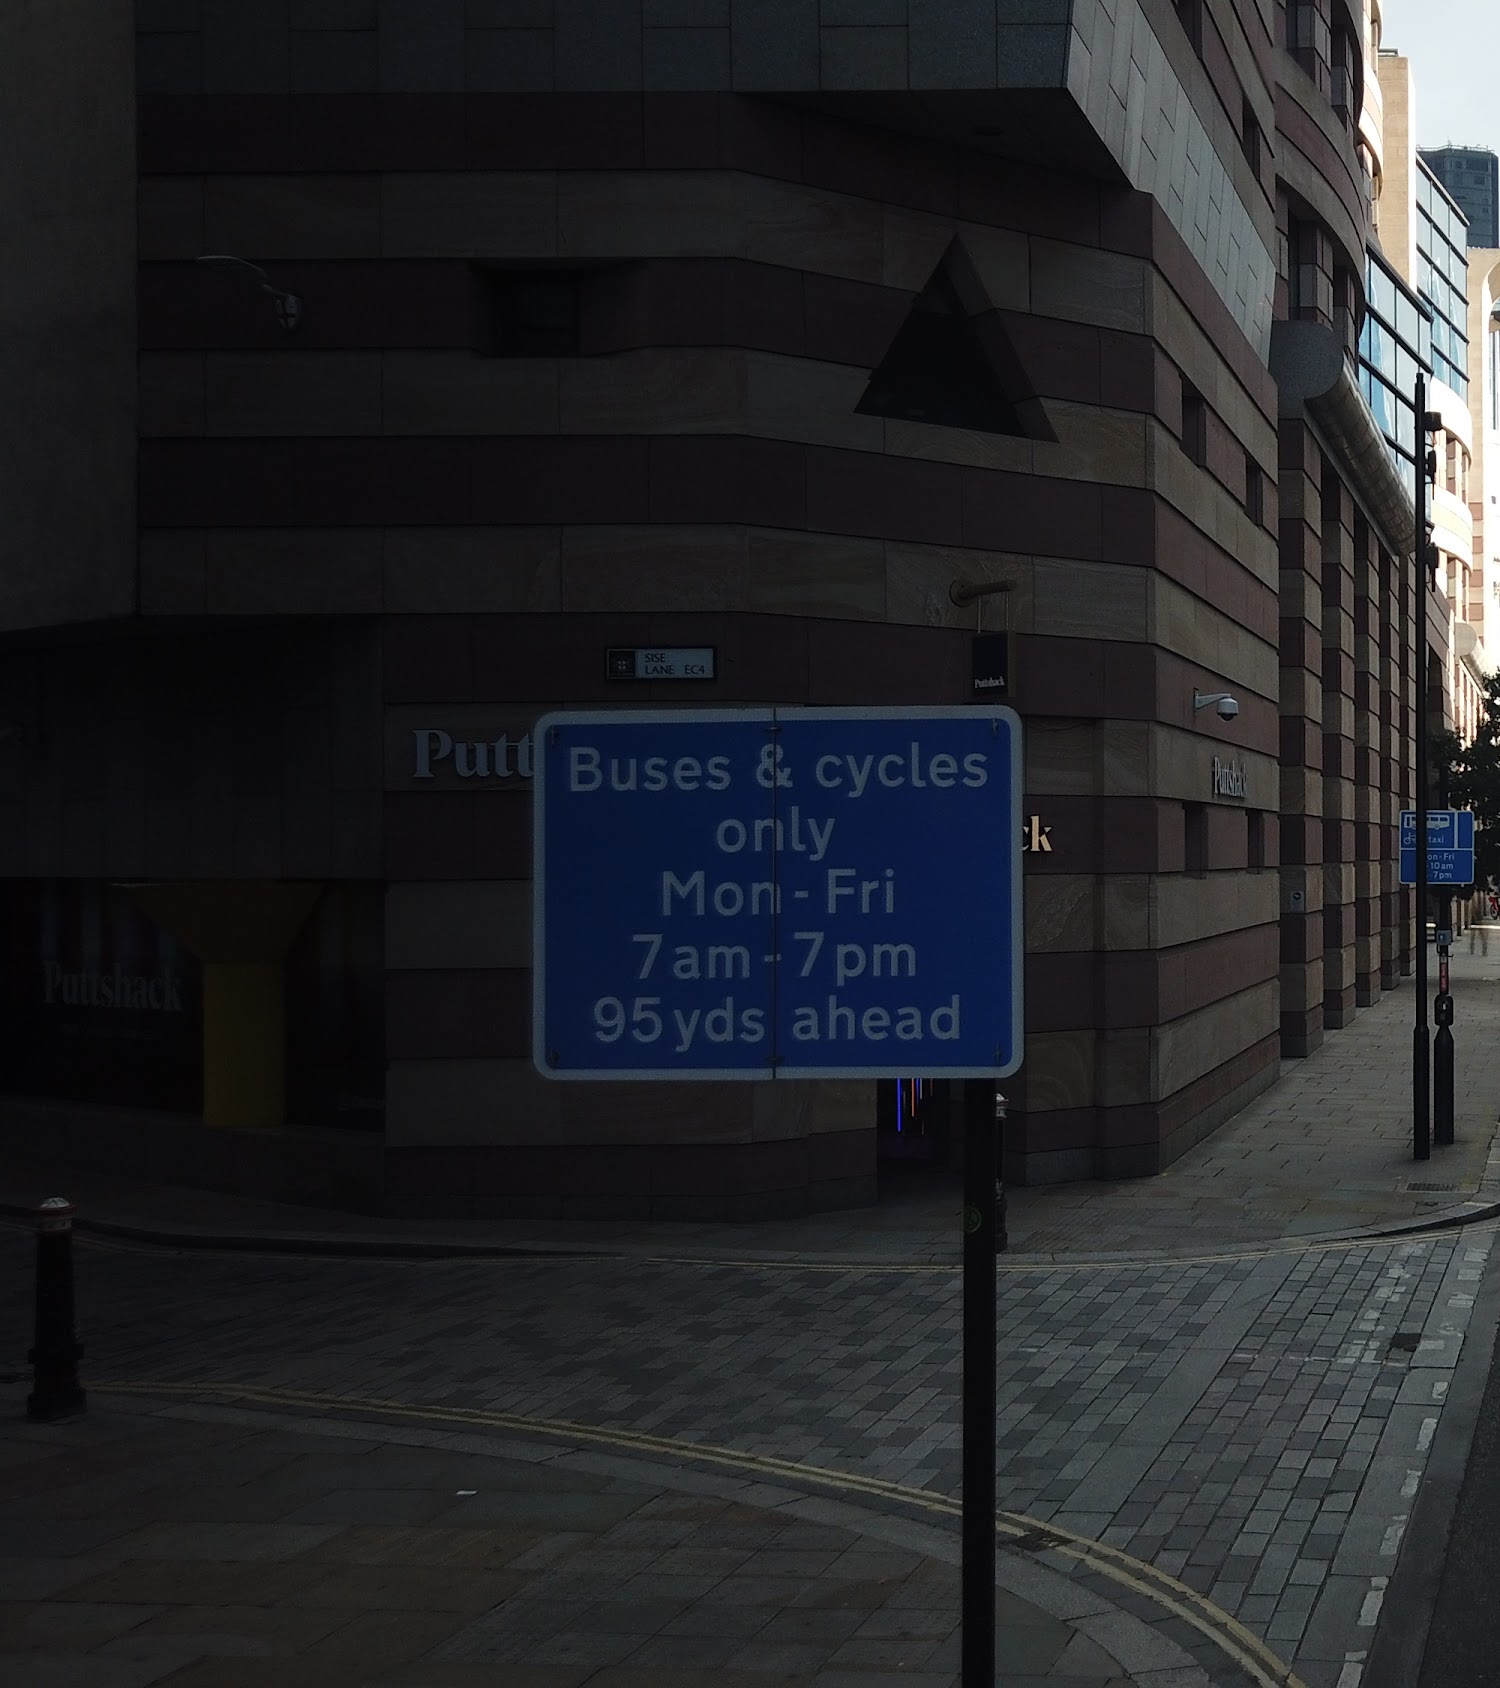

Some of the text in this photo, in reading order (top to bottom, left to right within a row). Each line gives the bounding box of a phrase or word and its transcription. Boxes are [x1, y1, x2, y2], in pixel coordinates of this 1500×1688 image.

[645, 653, 666, 663] SISE
[645, 664, 705, 675] LANE EC4
[569, 741, 989, 798] Buses & cycles
[716, 806, 836, 861] only
[1428, 835, 1445, 844] taxi
[791, 994, 961, 1041] ahead
